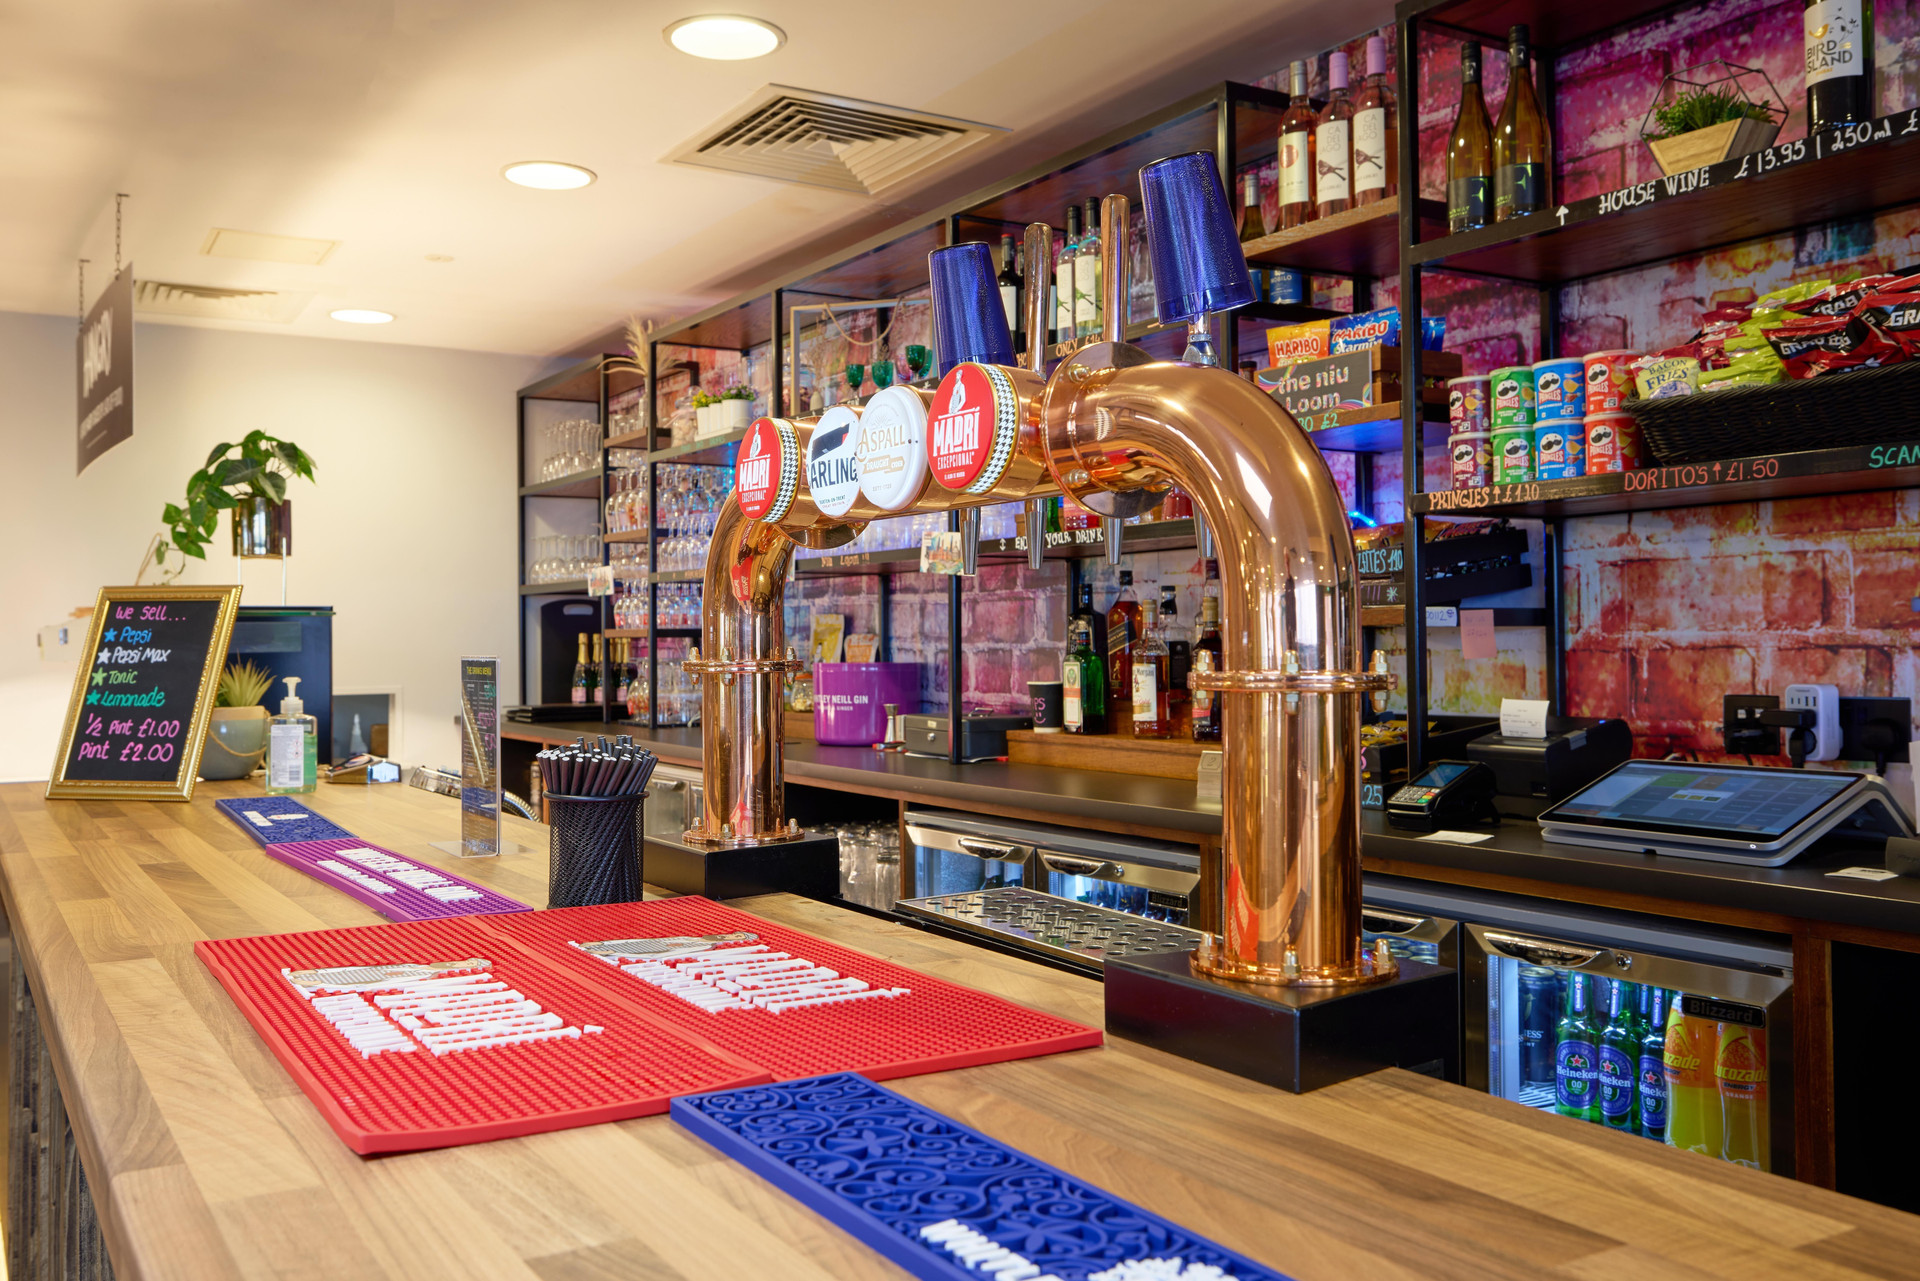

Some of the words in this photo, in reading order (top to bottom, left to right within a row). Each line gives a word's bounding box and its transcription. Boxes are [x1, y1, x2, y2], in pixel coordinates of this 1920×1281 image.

[1807, 40, 1837, 60] BIRD
[1807, 50, 1853, 74] SLAND
[1598, 180, 1657, 215] HOUSE
[1663, 166, 1710, 196] WINE
[1332, 319, 1389, 344] HARIBO
[1275, 336, 1321, 358] HARIBO
[1315, 364, 1349, 388] niu
[1648, 359, 1687, 375] BACON
[1645, 367, 1689, 390] FRIES
[1285, 392, 1341, 415] Loom
[1321, 413, 1340, 430] £2
[856, 424, 906, 462] ASPALL
[806, 456, 859, 491] ARLING
[1725, 458, 1779, 482] £1.50
[1428, 486, 1490, 511] PRINGLES
[1045, 531, 1072, 549] YOUR
[1075, 527, 1104, 544] DRINK
[120, 626, 153, 645] Pepsi
[111, 646, 142, 664] Pepsi
[141, 647, 171, 663] Max
[108, 669, 138, 684] Tonic
[100, 686, 165, 707] Lemonade
[831, 694, 852, 704] NEILL
[853, 695, 869, 705] GIN
[108, 719, 133, 735] Pint
[137, 717, 180, 738] £1.00
[78, 740, 110, 761] Pint
[119, 741, 174, 762] £2.00
[1361, 784, 1383, 806] .25
[1690, 999, 1754, 1023] Blizzard
[1556, 1064, 1599, 1080] Heineken
[1663, 1051, 1700, 1071] ozade
[1598, 1071, 1631, 1088] ineken
[1639, 1081, 1668, 1098] eineke
